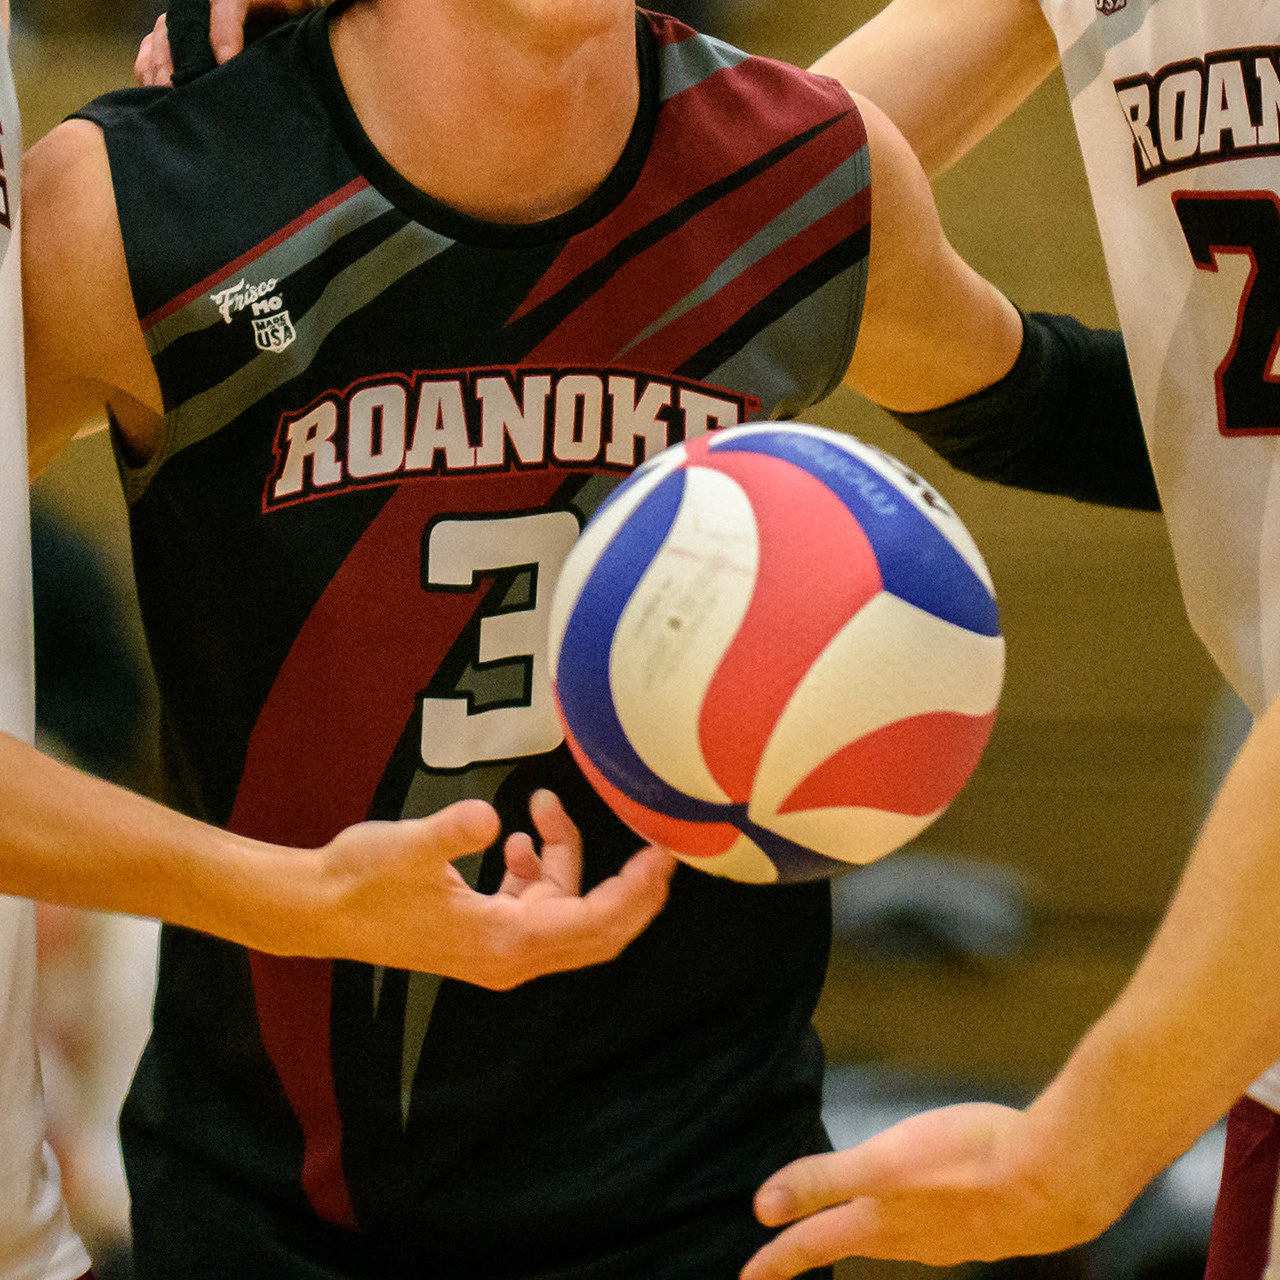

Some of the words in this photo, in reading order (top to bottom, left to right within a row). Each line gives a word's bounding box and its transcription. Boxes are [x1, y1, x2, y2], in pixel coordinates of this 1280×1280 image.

[210, 278, 279, 324] Frisco
[255, 314, 286, 331] MADE
[258, 325, 293, 347] USA
[420, 512, 580, 770] 3
